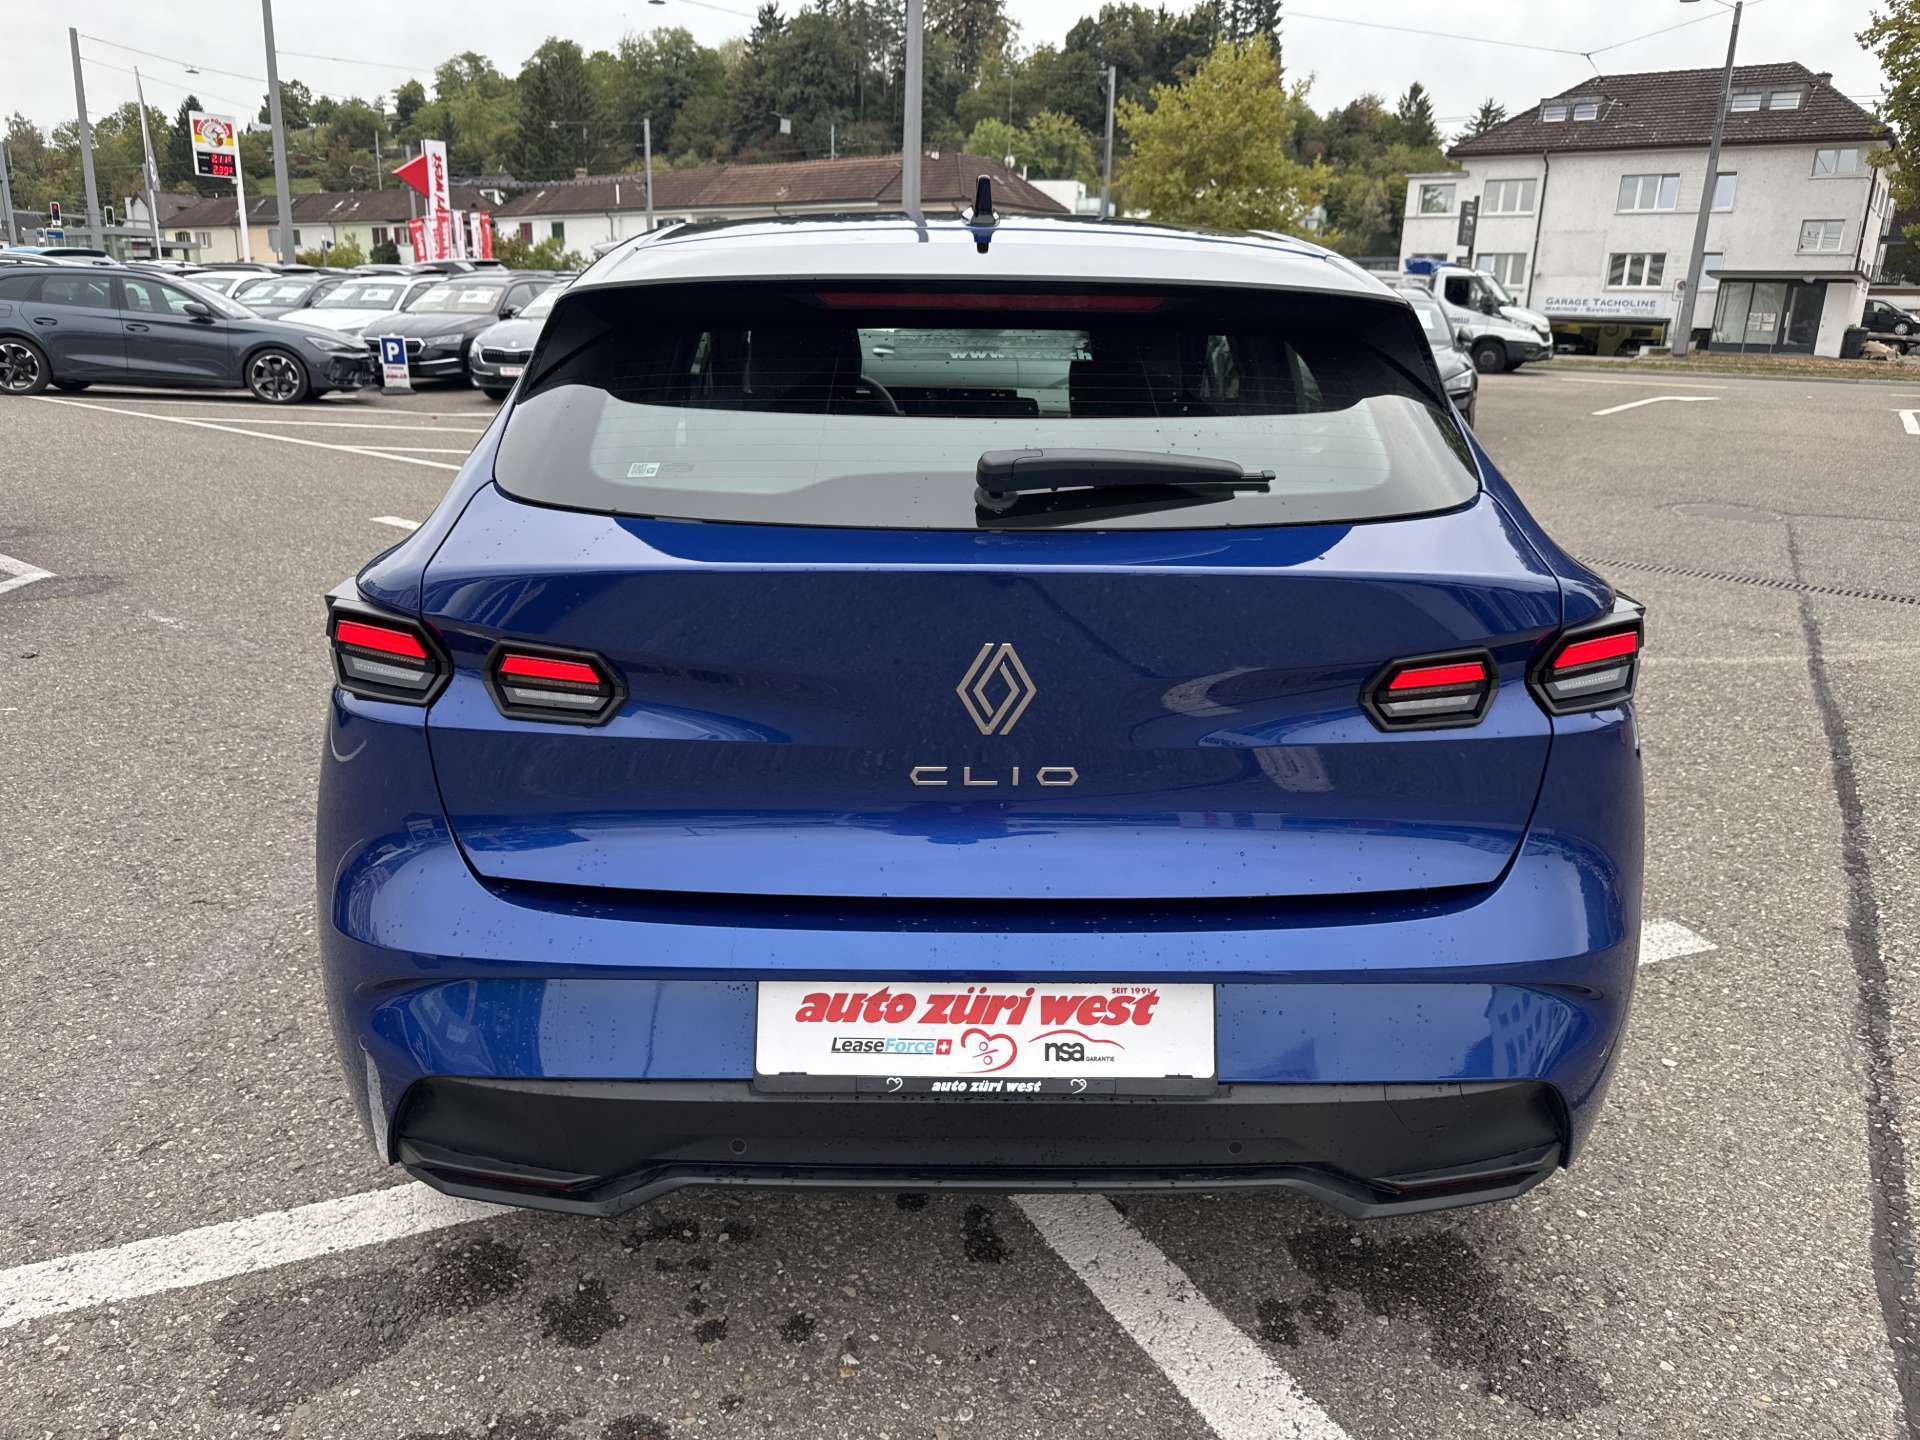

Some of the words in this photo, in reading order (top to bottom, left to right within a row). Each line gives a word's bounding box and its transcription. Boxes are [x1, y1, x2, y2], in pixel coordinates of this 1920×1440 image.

[1545, 297, 1588, 306] GARAGE
[1593, 298, 1656, 308] TACHOLINE
[386, 341, 400, 362] P
[909, 766, 1079, 786] CLIO
[795, 985, 917, 1024] auto
[917, 986, 1035, 1025] züri
[1040, 988, 1160, 1026] west
[831, 1037, 936, 1053] LeaseForce
[1044, 1042, 1085, 1062] nsa
[931, 1080, 968, 1092] auto
[969, 1080, 1004, 1092] züri
[1006, 1082, 1042, 1093] west
